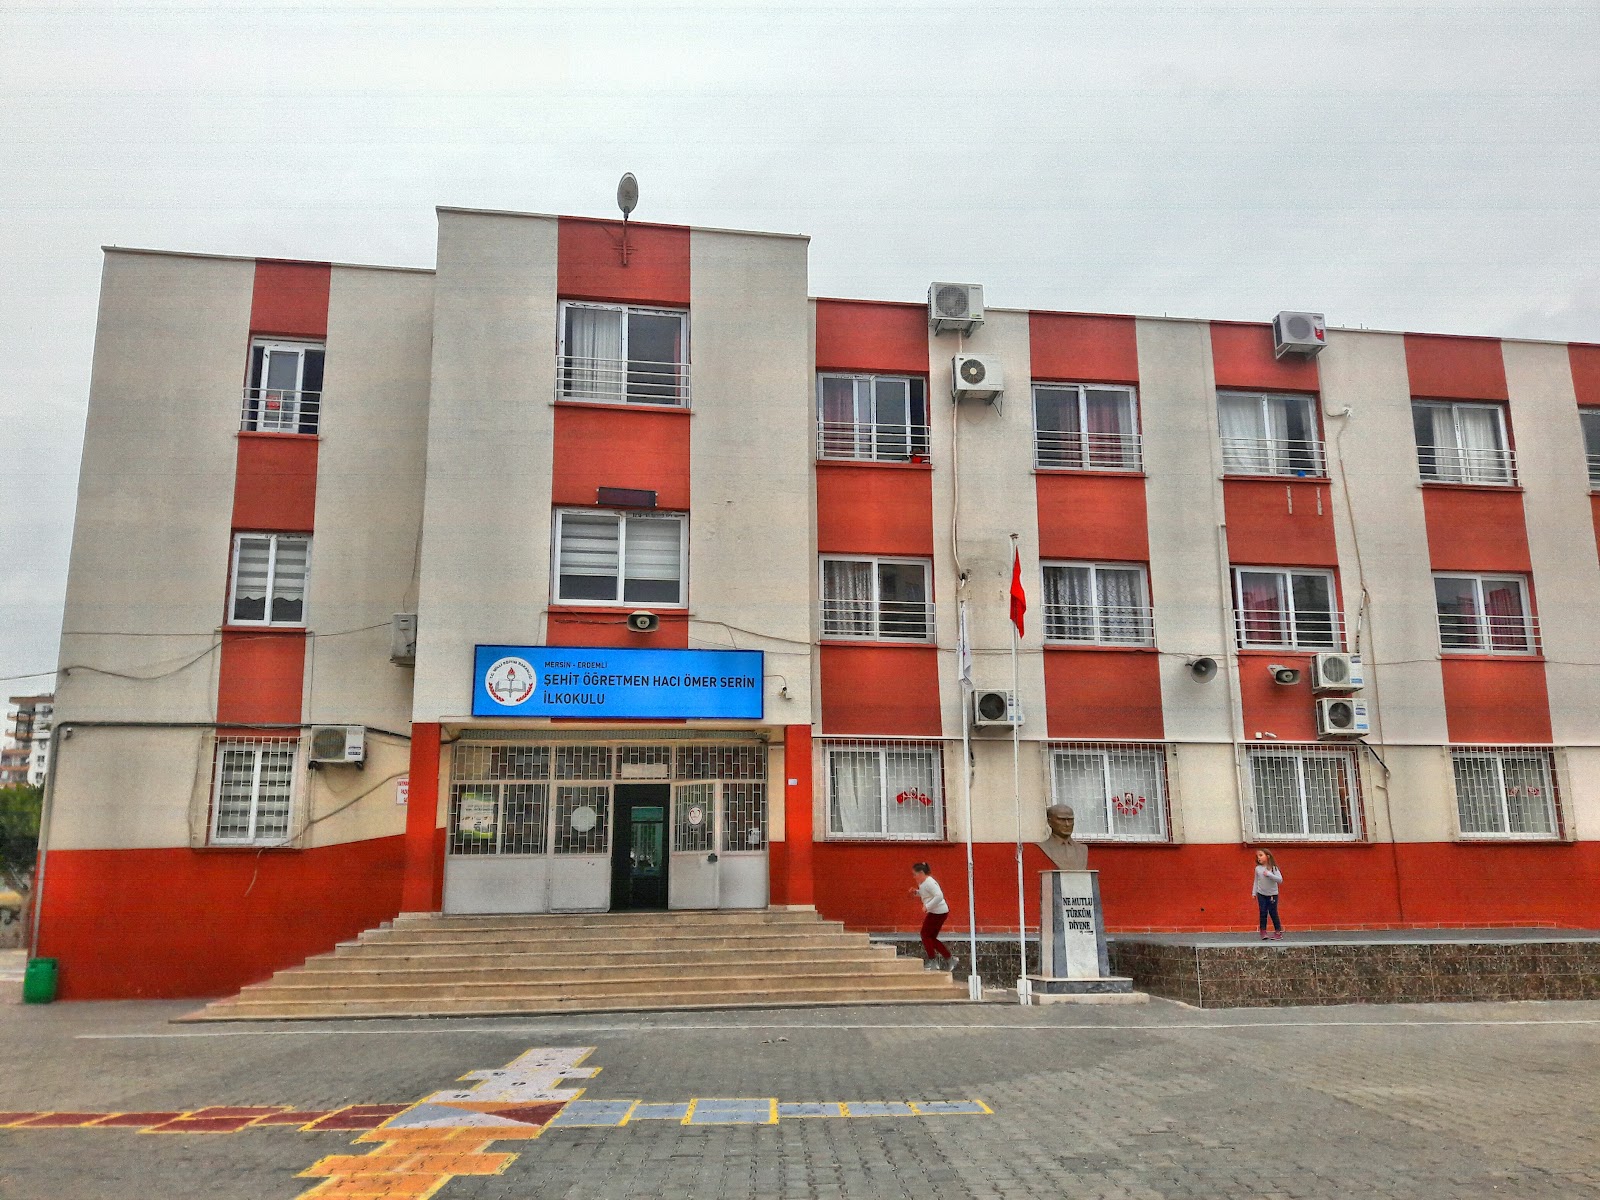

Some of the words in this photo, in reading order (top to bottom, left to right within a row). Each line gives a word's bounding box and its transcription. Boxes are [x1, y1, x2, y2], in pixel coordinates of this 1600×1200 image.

[577, 661, 608, 669] ERDEMLİ
[544, 672, 580, 687] ŞEHİT
[583, 672, 649, 687] ÖĞRETMEN
[653, 675, 680, 687] HACI
[684, 673, 717, 688] ÖMER
[720, 674, 755, 688] SERİN
[543, 690, 605, 705] İLKOKULU
[1063, 898, 1071, 906] NE
[1072, 898, 1092, 906] MUTLU
[1066, 908, 1091, 918] TÜRKÜM
[1069, 920, 1090, 930] DİYENE
